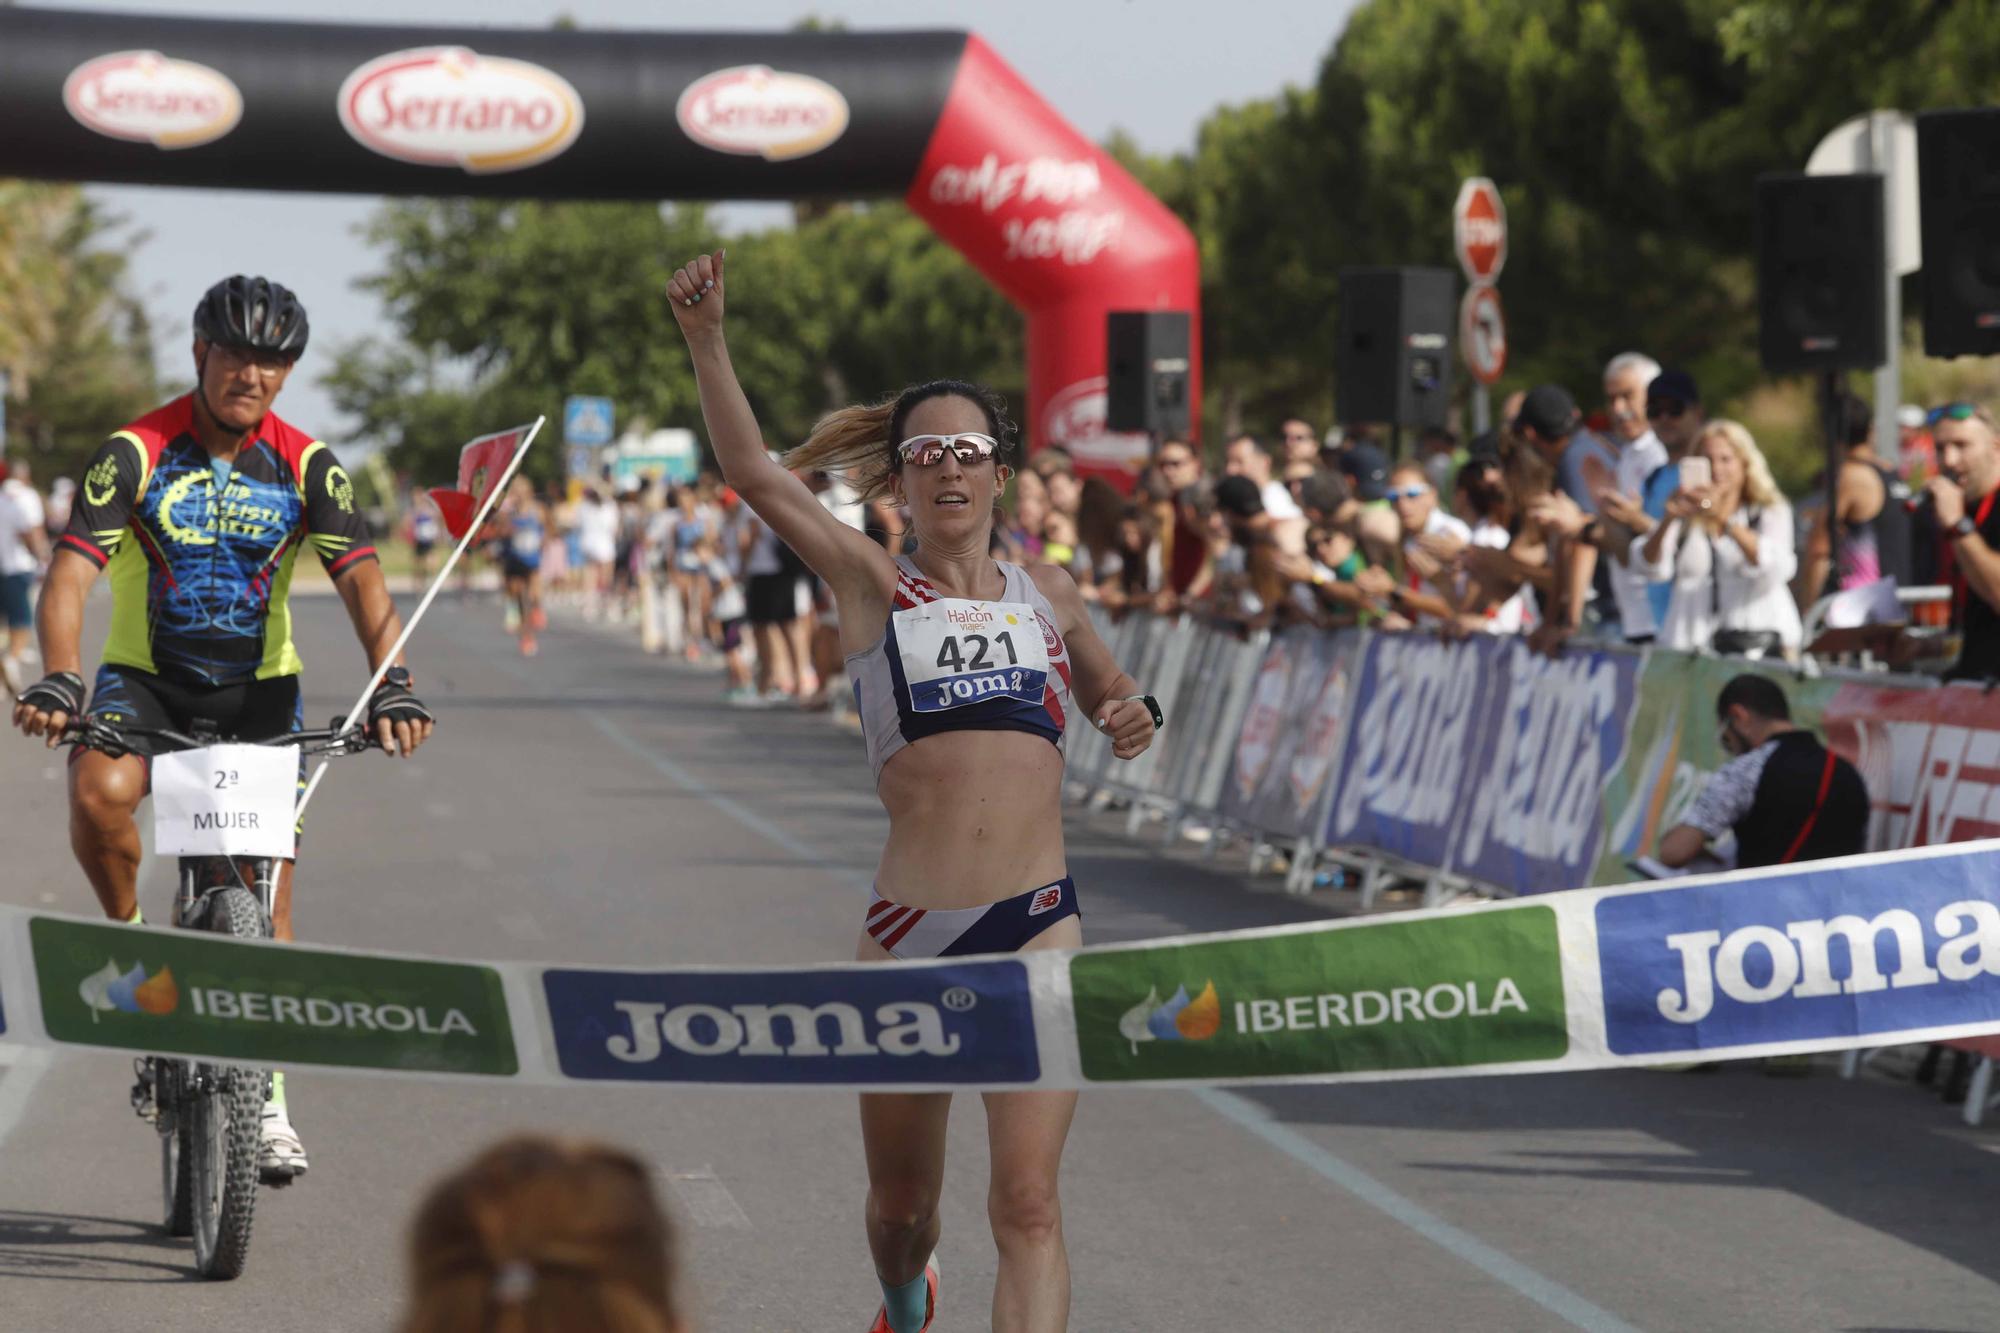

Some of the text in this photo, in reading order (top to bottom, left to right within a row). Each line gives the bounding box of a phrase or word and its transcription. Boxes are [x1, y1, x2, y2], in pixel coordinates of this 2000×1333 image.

[378, 84, 555, 131] Serrano
[937, 631, 1018, 673] 421
[214, 770, 239, 790] 2ª
[194, 812, 260, 831] MUJER
[190, 986, 478, 1037] IBERDROLA
[1234, 977, 1530, 1034] IBERDROLA
